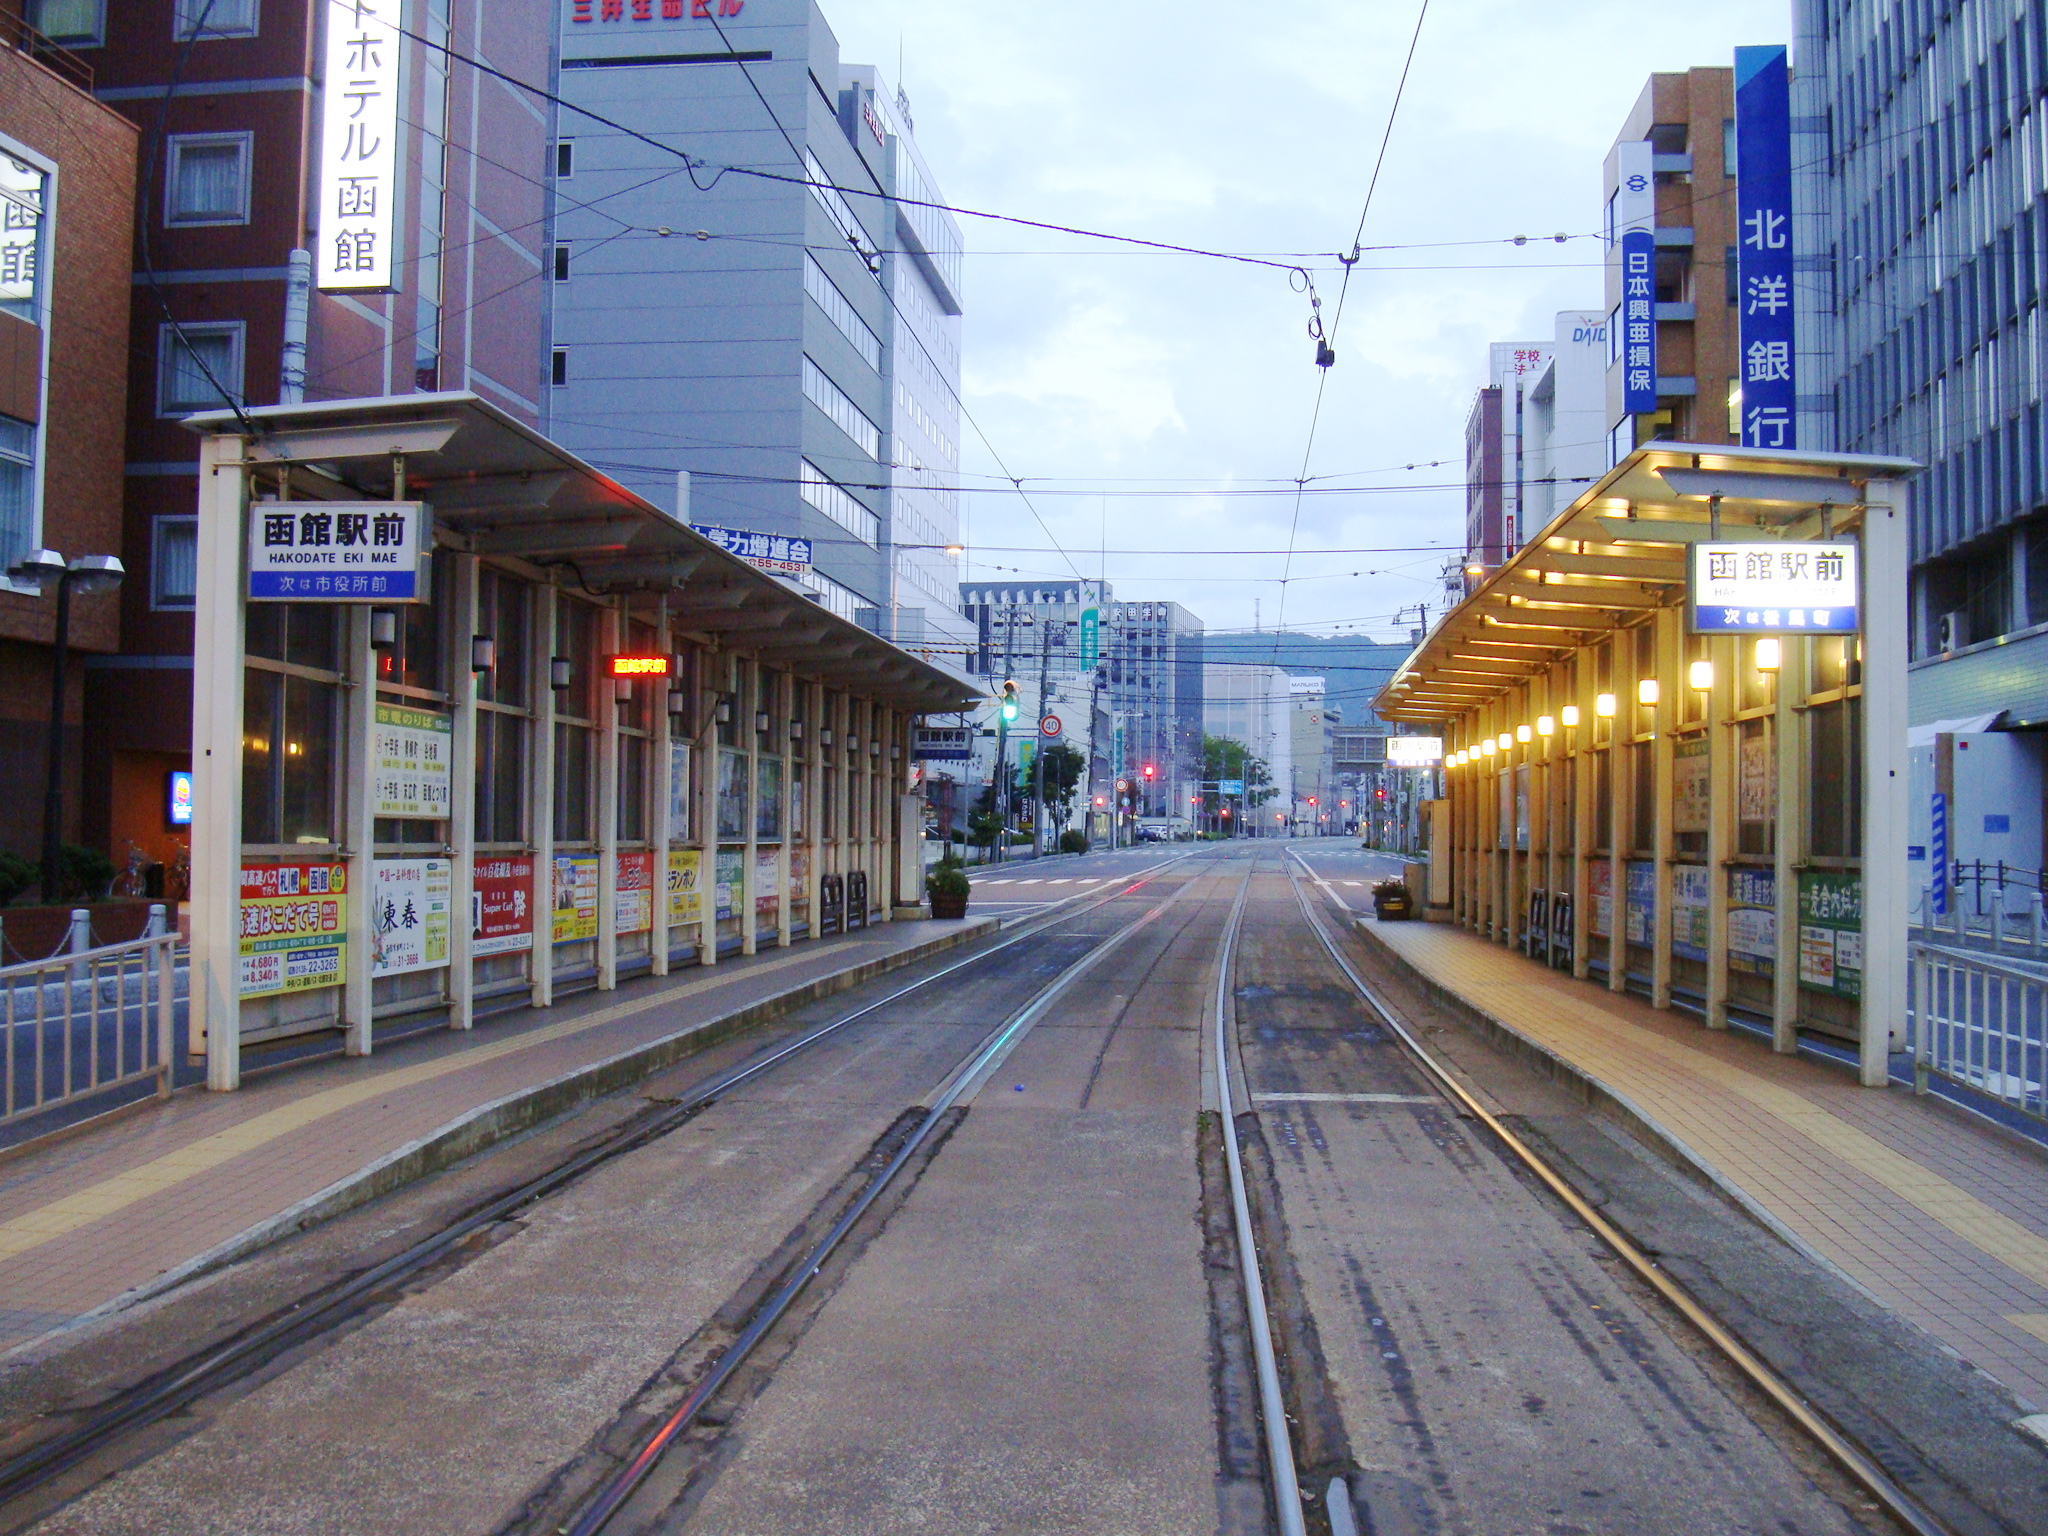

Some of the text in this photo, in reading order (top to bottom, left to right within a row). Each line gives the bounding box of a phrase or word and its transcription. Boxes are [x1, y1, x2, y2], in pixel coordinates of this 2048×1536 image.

[572, 0, 744, 21] 三井生命ビル
[334, 0, 383, 273] トホテル函館
[1628, 252, 1651, 391] 日本興亜損保
[1745, 209, 1790, 447] 北洋銀行
[1514, 350, 1540, 362] 学校
[264, 512, 406, 547] 函館駅前
[269, 552, 398, 564] HAKODATE EKI MAE
[757, 558, 806, 573] 55-4531
[1708, 551, 1844, 582] 函館駅前
[279, 576, 388, 593] 次は市役所前
[614, 658, 667, 674] 函館駅前
[1045, 720, 1057, 730] 40
[382, 899, 419, 933] 東春
